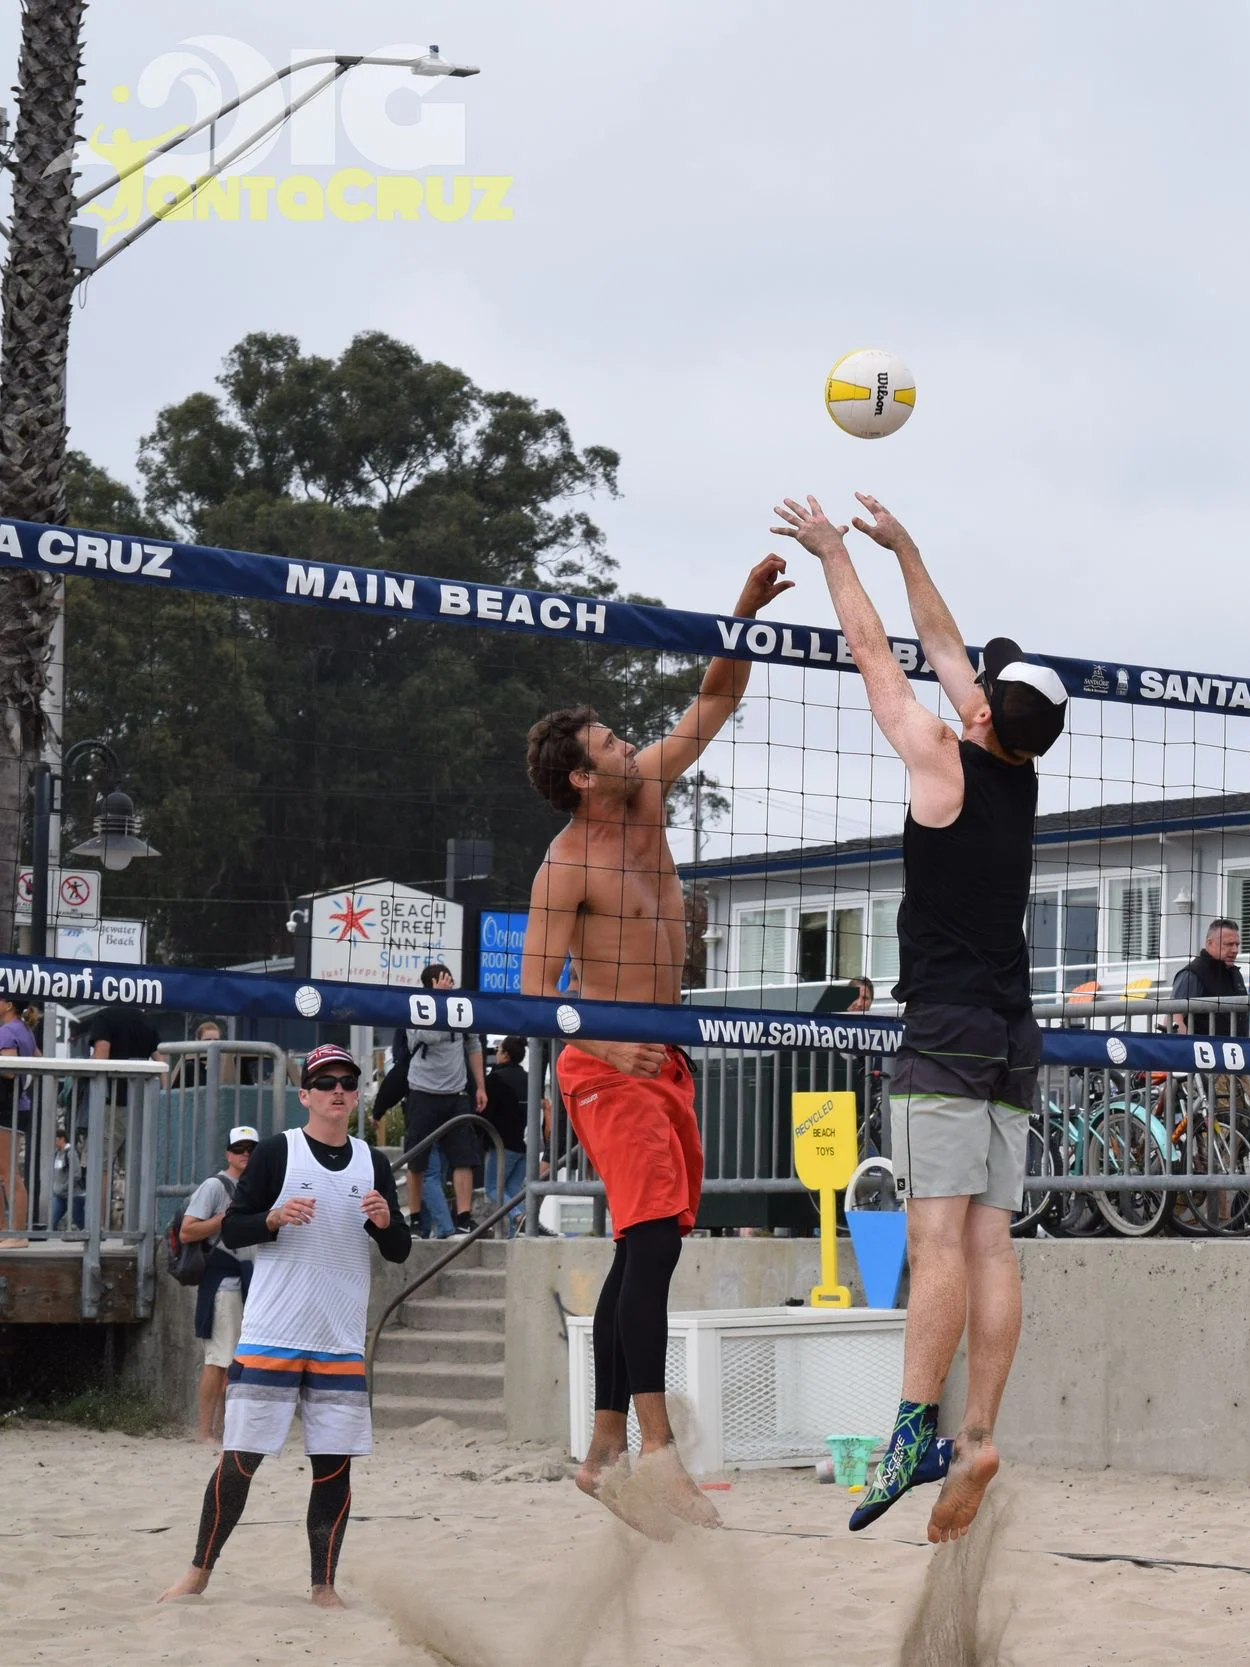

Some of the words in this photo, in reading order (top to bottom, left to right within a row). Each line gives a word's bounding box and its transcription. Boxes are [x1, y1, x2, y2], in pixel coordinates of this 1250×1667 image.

[874, 371, 890, 417] Wilson
[38, 531, 174, 578] CRUZ
[286, 564, 415, 609] MAIN
[440, 584, 607, 634] BEACH
[716, 619, 986, 679] VOLLEB
[380, 900, 447, 919] BEACH
[380, 918, 447, 937] STREET
[105, 934, 136, 947] Beach
[382, 937, 418, 951] INN
[380, 951, 446, 969] SUITES
[481, 952, 519, 969] ROOMS
[484, 972, 511, 989] POOL
[512, 975, 521, 990] &
[698, 1018, 906, 1053] www.santacruzw
[794, 1099, 834, 1139] RECYCLED
[812, 1127, 836, 1138] BEACH
[815, 1146, 835, 1157] TOYS
[872, 1433, 906, 1490] VINCERE
